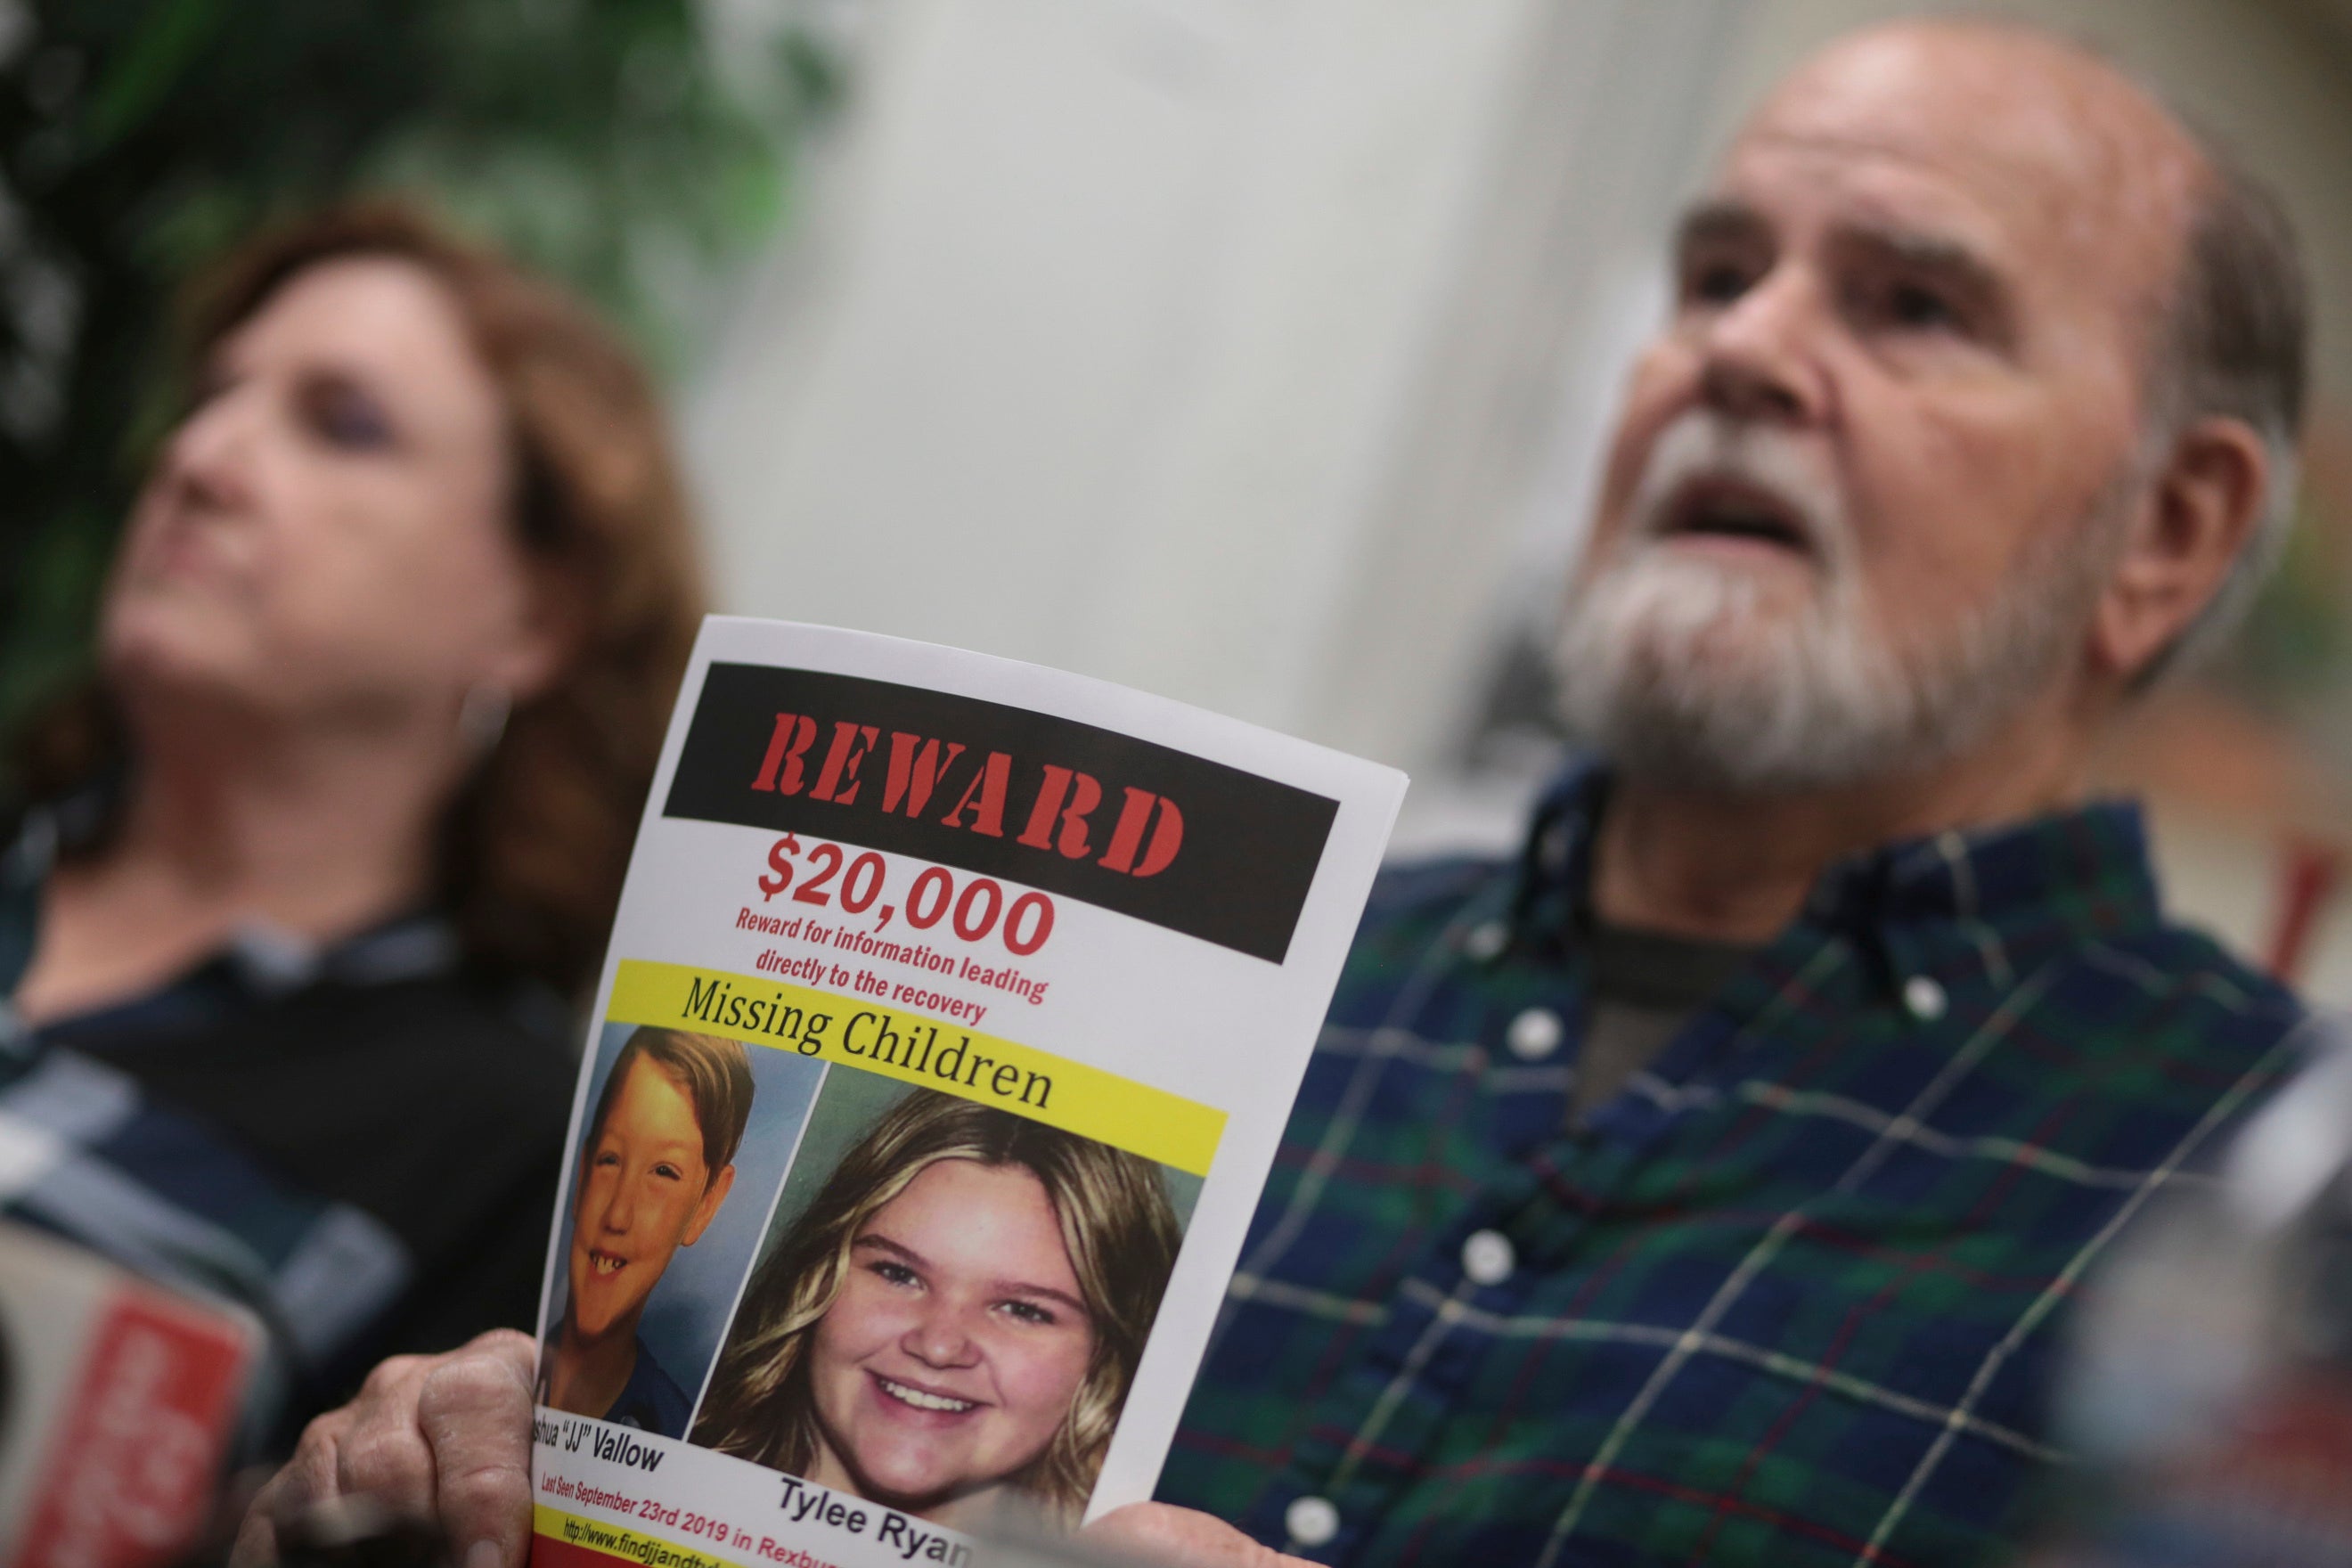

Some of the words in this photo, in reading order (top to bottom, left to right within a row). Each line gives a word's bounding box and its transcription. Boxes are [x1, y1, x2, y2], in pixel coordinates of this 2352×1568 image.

[751, 712, 1184, 877] REWARD
[758, 830, 1055, 957] $20,000
[736, 906, 802, 938] Reward
[804, 919, 833, 945] for
[834, 926, 955, 976] information
[959, 956, 1049, 1005] leading
[755, 949, 828, 986] directly
[829, 964, 849, 989] to
[853, 968, 889, 997] the
[892, 981, 988, 1027] recovery
[681, 976, 834, 1058] Missing
[842, 1010, 1055, 1110] Children
[533, 1413, 559, 1448] shua
[592, 1425, 666, 1473] Vallow
[542, 1472, 557, 1494] Last
[556, 1474, 576, 1498] Seen
[575, 1480, 638, 1515] September
[638, 1499, 681, 1527] 23rd
[681, 1512, 730, 1542] 2019
[731, 1527, 753, 1551] in
[756, 1537, 838, 1568] Rexbu
[780, 1476, 867, 1534] Tylee
[877, 1512, 975, 1568] Ryan
